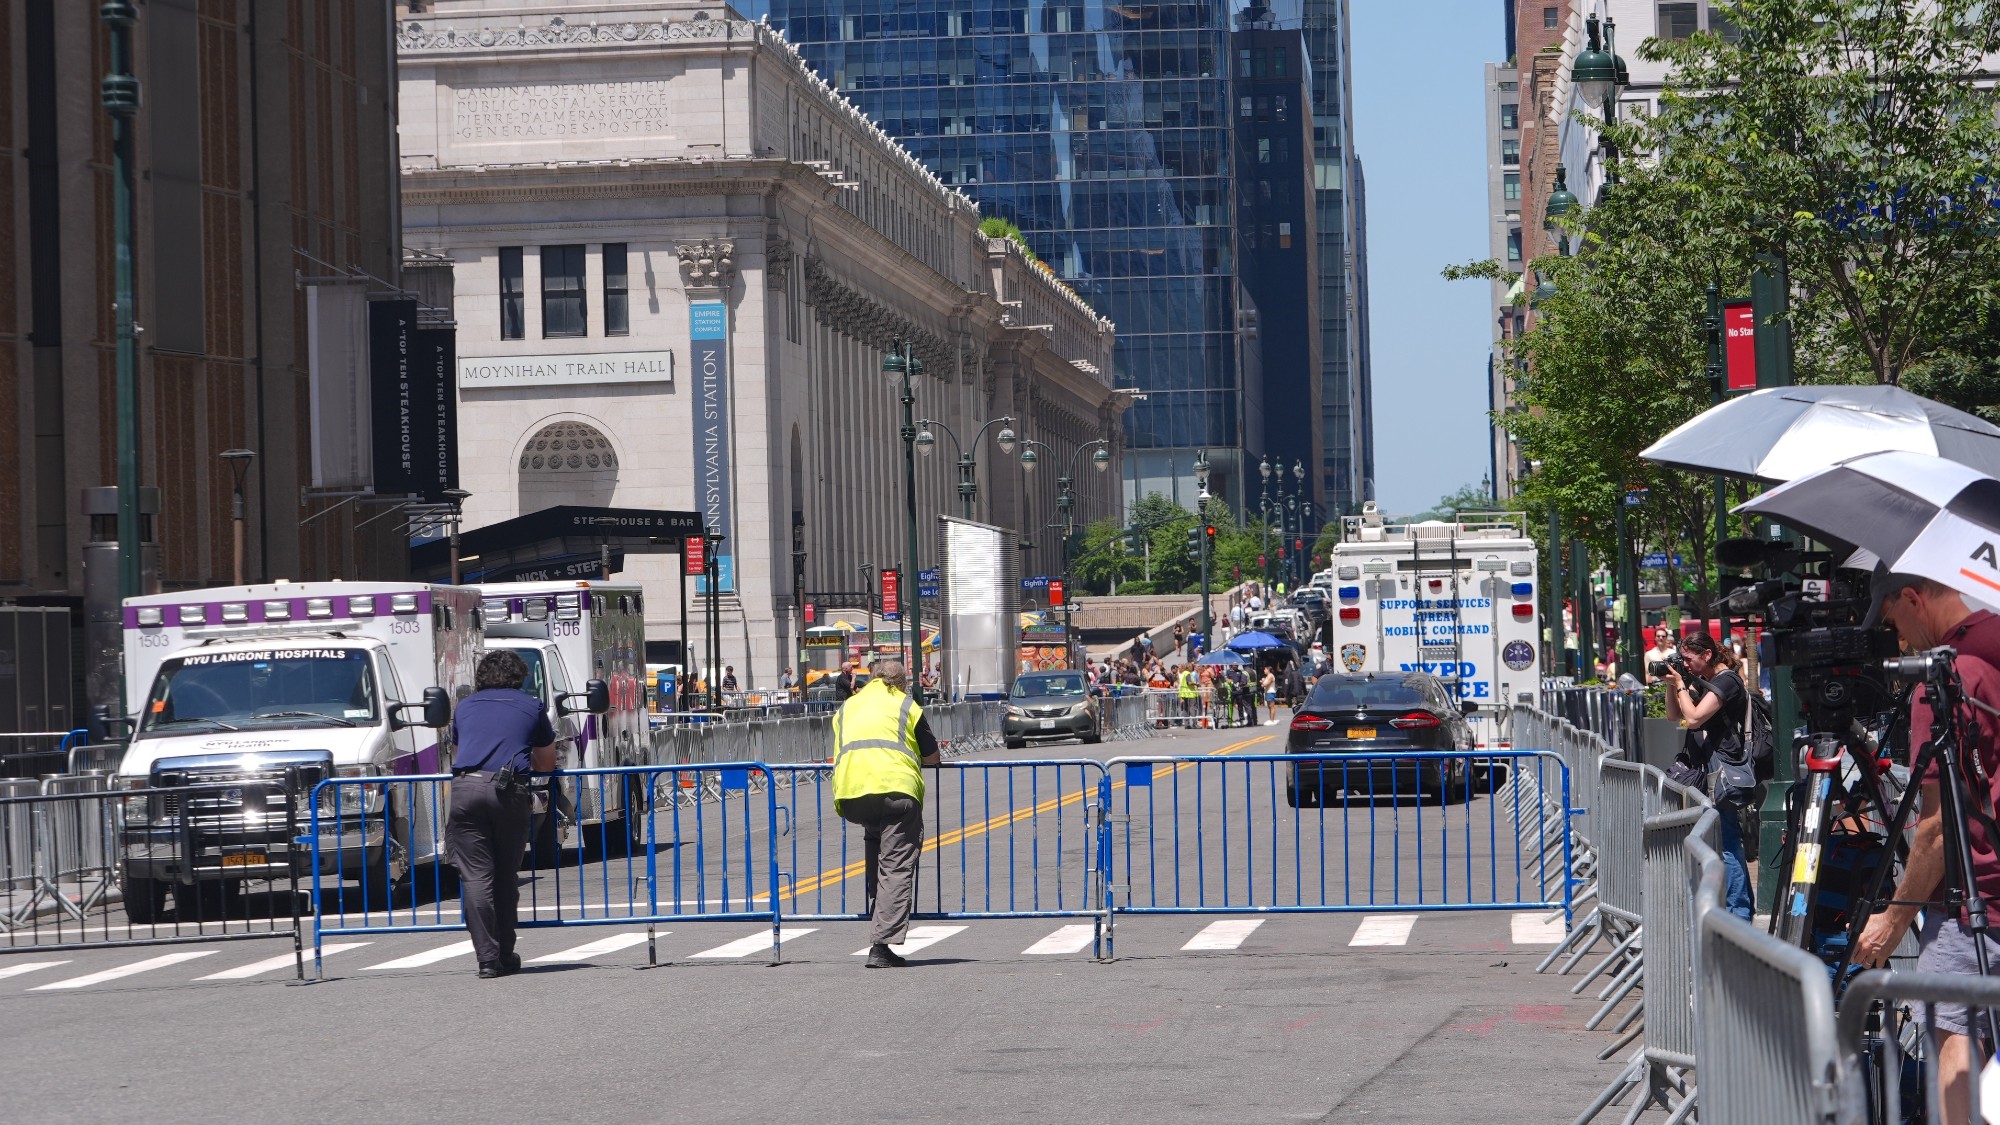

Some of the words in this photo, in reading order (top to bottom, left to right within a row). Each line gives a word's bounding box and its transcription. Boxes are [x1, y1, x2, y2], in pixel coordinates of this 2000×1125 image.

[457, 99, 520, 113] PUBLIC
[529, 97, 592, 110] POSTAL
[599, 94, 667, 108] SERVICE
[457, 112, 513, 126] PIERRE
[461, 124, 548, 139] GENERAL
[556, 121, 590, 135] DES
[600, 119, 663, 134] POSTES
[695, 310, 720, 318] EMPIRE
[1728, 328, 1739, 337] No
[400, 358, 408, 379] TEN
[464, 364, 558, 379] MOYNIHAN
[565, 362, 616, 376] TRAIN
[624, 360, 666, 374] HALL
[437, 381, 445, 401] TEN
[703, 350, 718, 420] STATION
[704, 425, 721, 545] ENNSYLVANIA
[573, 516, 651, 526] STEOUSE
[656, 518, 665, 526] &
[670, 518, 695, 527] BAR
[1969, 541, 2000, 572] A
[515, 569, 548, 582] NICK
[566, 558, 603, 577] STEF'
[1024, 580, 1044, 588] Eighth
[1380, 599, 1432, 610] SUPPORT
[1436, 598, 1491, 609] SERVICES
[389, 620, 421, 635] 1503
[544, 620, 580, 637] 1506
[1385, 626, 1428, 636] MOBILE
[1432, 624, 1490, 635] COMMAND
[138, 634, 170, 647] 1503
[1423, 638, 1452, 646] POST
[183, 656, 210, 666] NYU
[212, 651, 272, 663] LANGONE
[275, 649, 346, 660] HOSPITALS
[1400, 661, 1477, 678] NYPD
[664, 682, 672, 693] P
[1444, 681, 1489, 698] ICE
